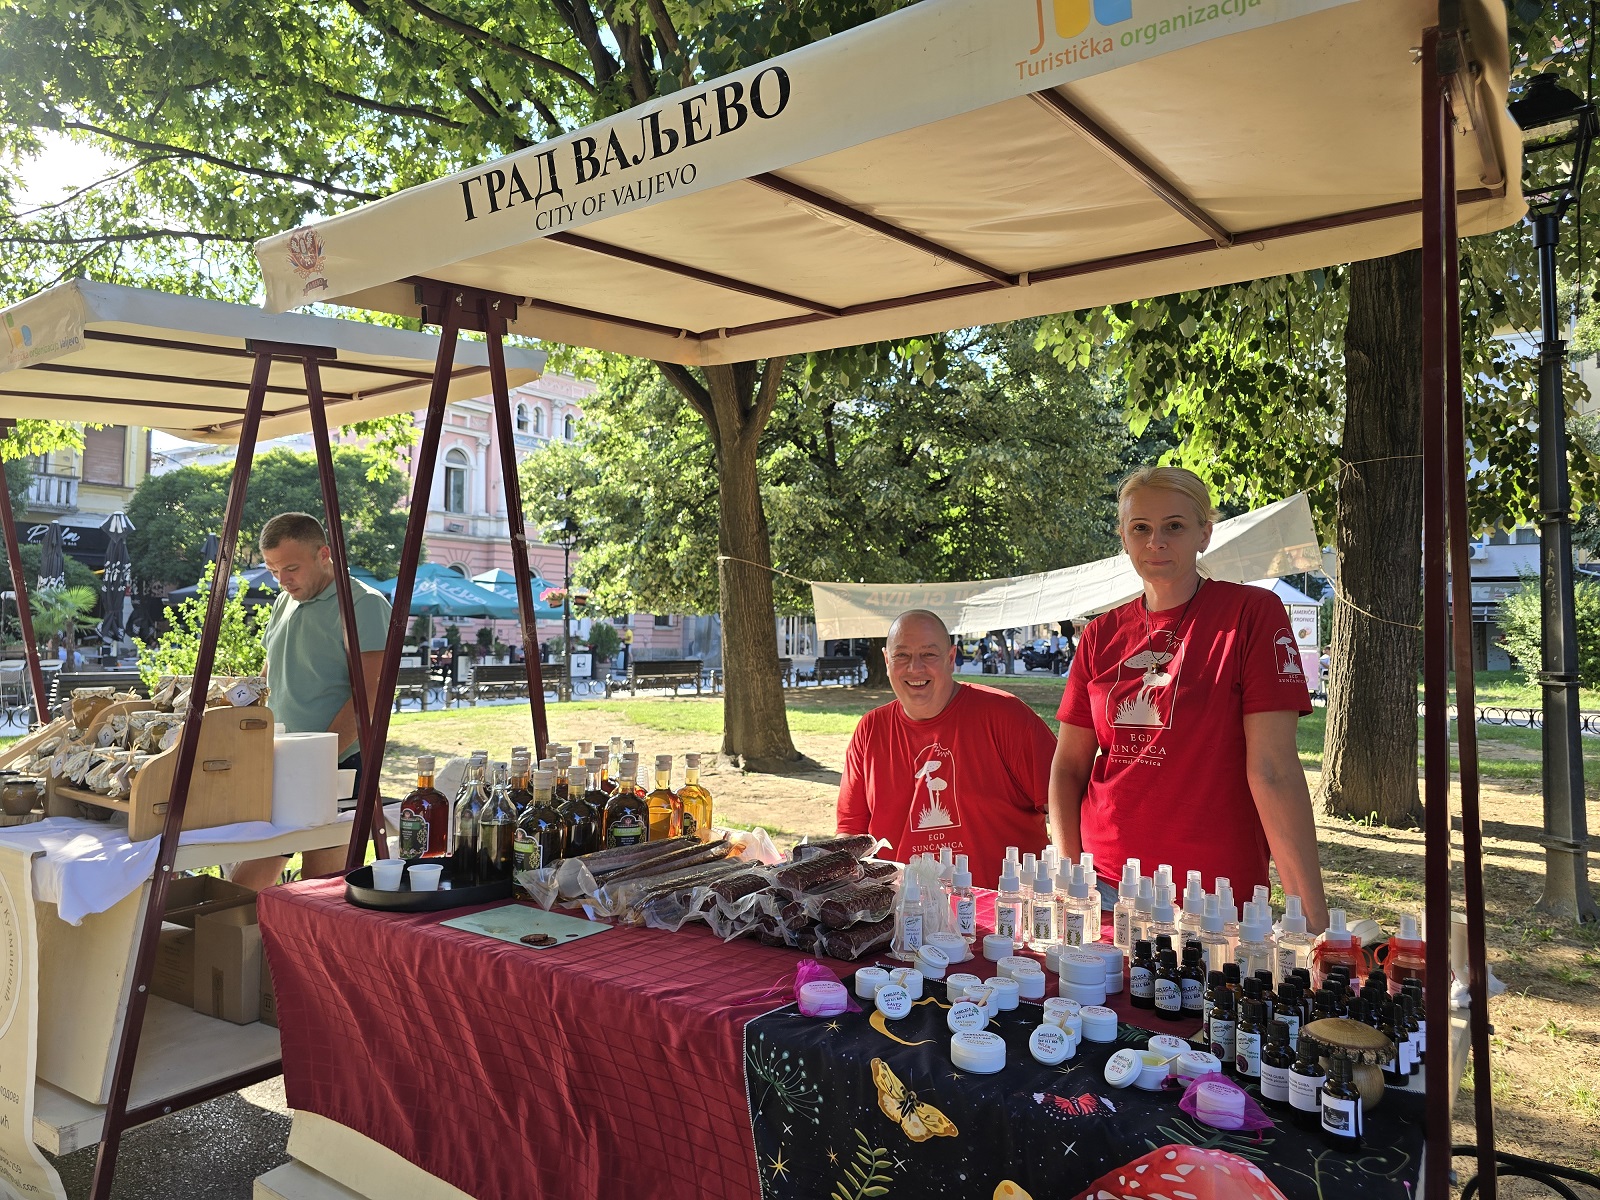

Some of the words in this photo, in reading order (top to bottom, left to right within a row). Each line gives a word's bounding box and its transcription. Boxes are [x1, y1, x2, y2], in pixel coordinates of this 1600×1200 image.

[1015, 37, 1113, 80] Turistička
[459, 148, 564, 222] ГРАД
[571, 66, 791, 185] ВАЉЕВО
[535, 200, 578, 231] CITY
[582, 192, 606, 218] OF
[612, 163, 697, 208] VALJEVO
[1130, 733, 1152, 742] EGD
[928, 832, 945, 841] EGD
